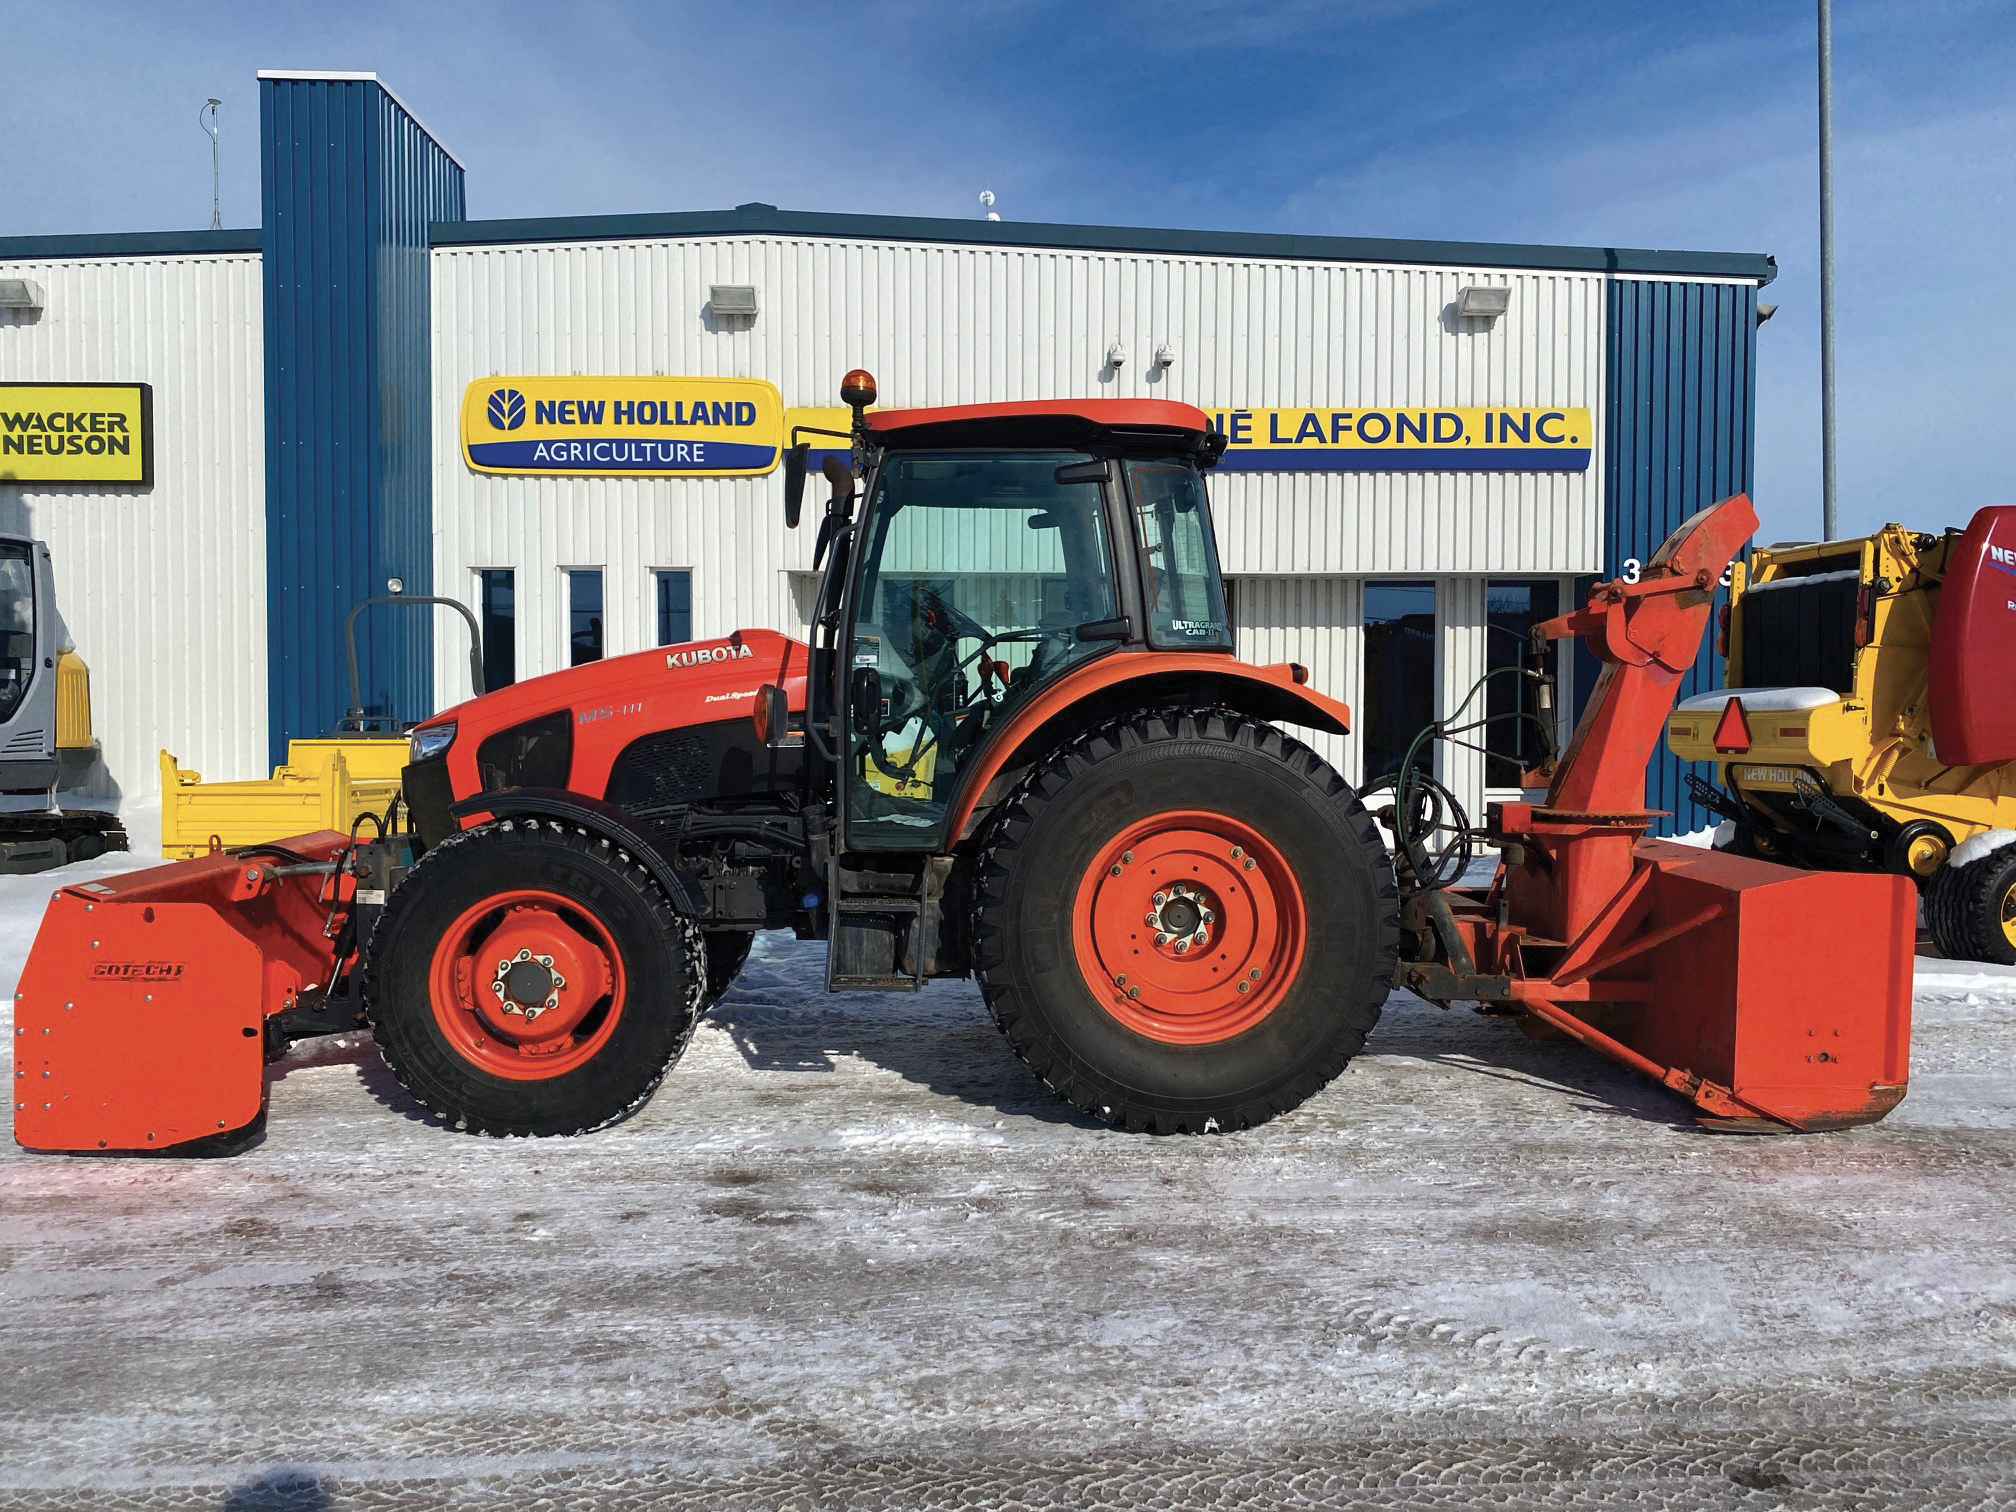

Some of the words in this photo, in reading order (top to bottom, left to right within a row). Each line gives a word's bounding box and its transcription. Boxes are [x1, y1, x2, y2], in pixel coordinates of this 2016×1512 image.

[0, 411, 130, 433] WACKER
[535, 400, 606, 425] NEW
[613, 400, 757, 427] HOLLAND
[1269, 412, 1473, 446] LAFOND,
[1485, 412, 1579, 444] INC.
[2, 434, 130, 456] NEUSON
[533, 441, 706, 463] AGRICULTURE
[1990, 545, 2016, 566] NE
[1622, 558, 1641, 585] 3
[666, 643, 755, 670] KUBOTA
[1743, 767, 1767, 781] NEW
